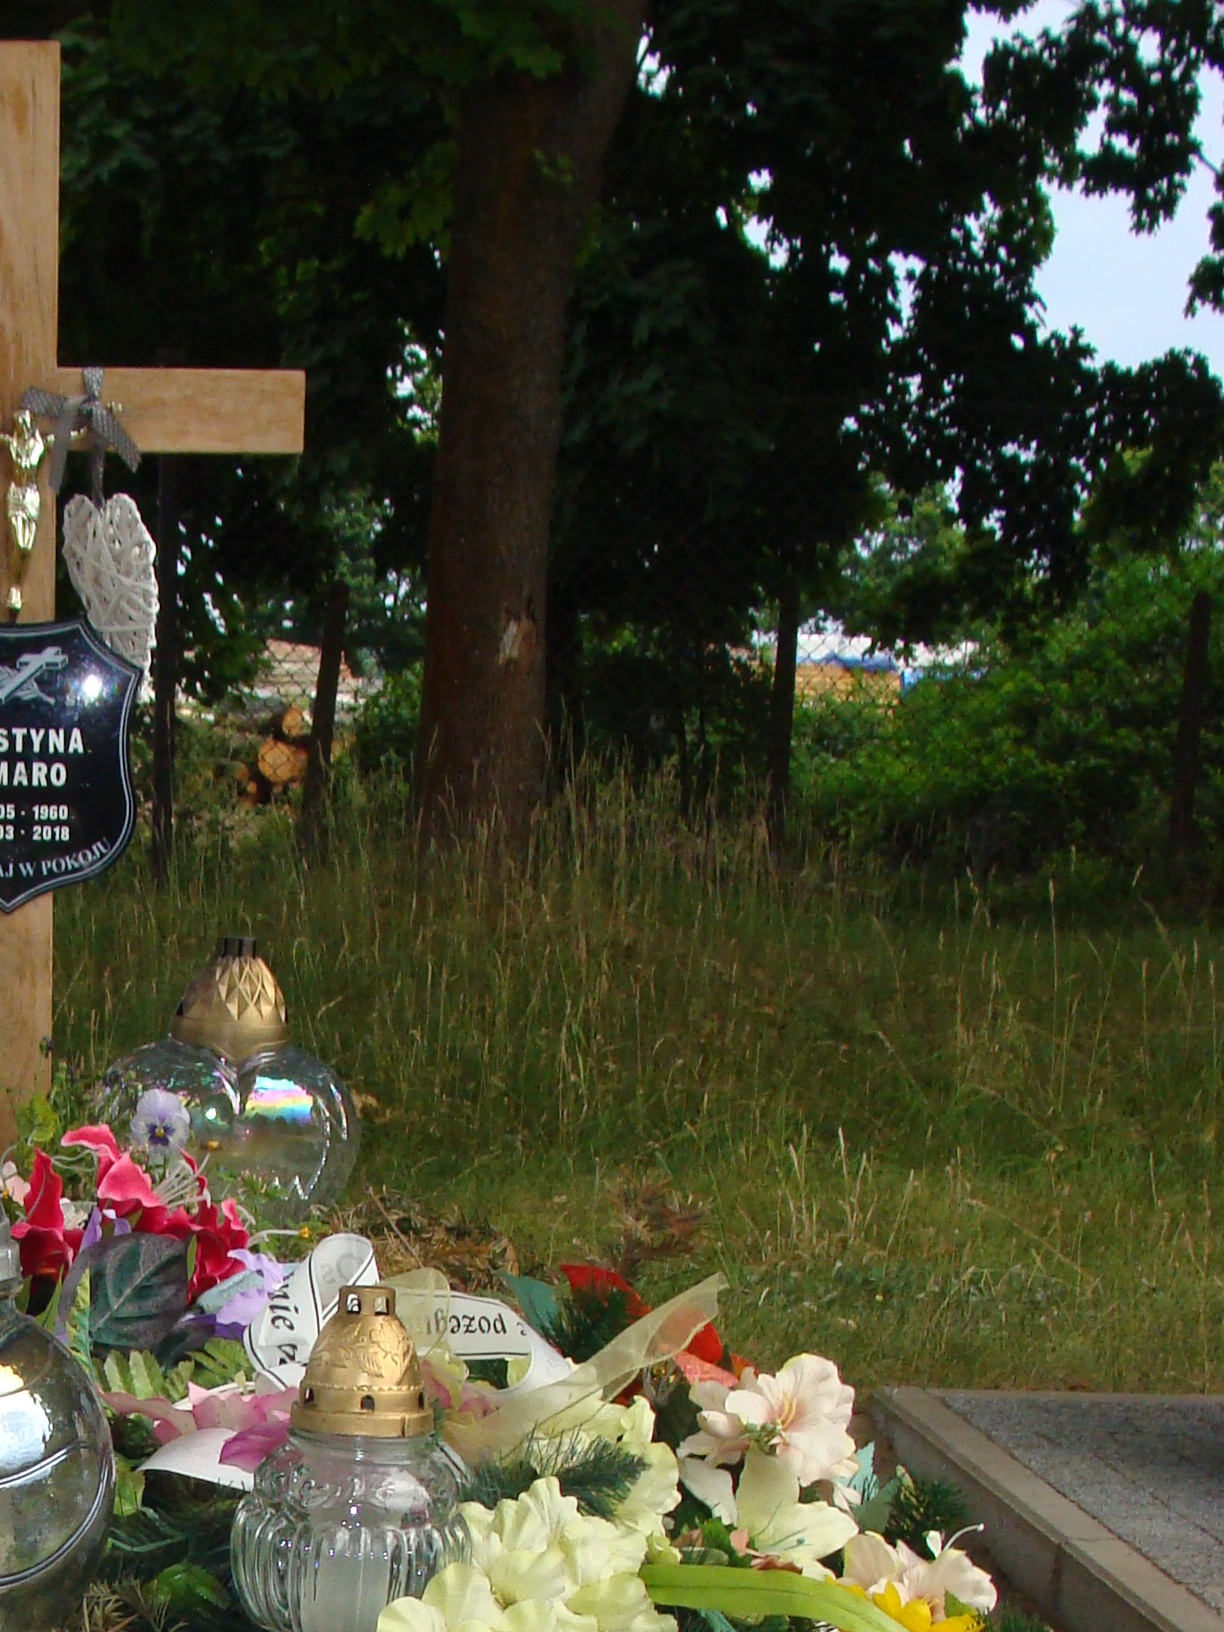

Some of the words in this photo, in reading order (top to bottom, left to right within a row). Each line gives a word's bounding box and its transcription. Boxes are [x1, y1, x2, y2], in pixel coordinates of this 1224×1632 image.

[32, 826, 70, 841] 2018
[19, 861, 37, 877] W
[41, 837, 112, 876] POKOJU
